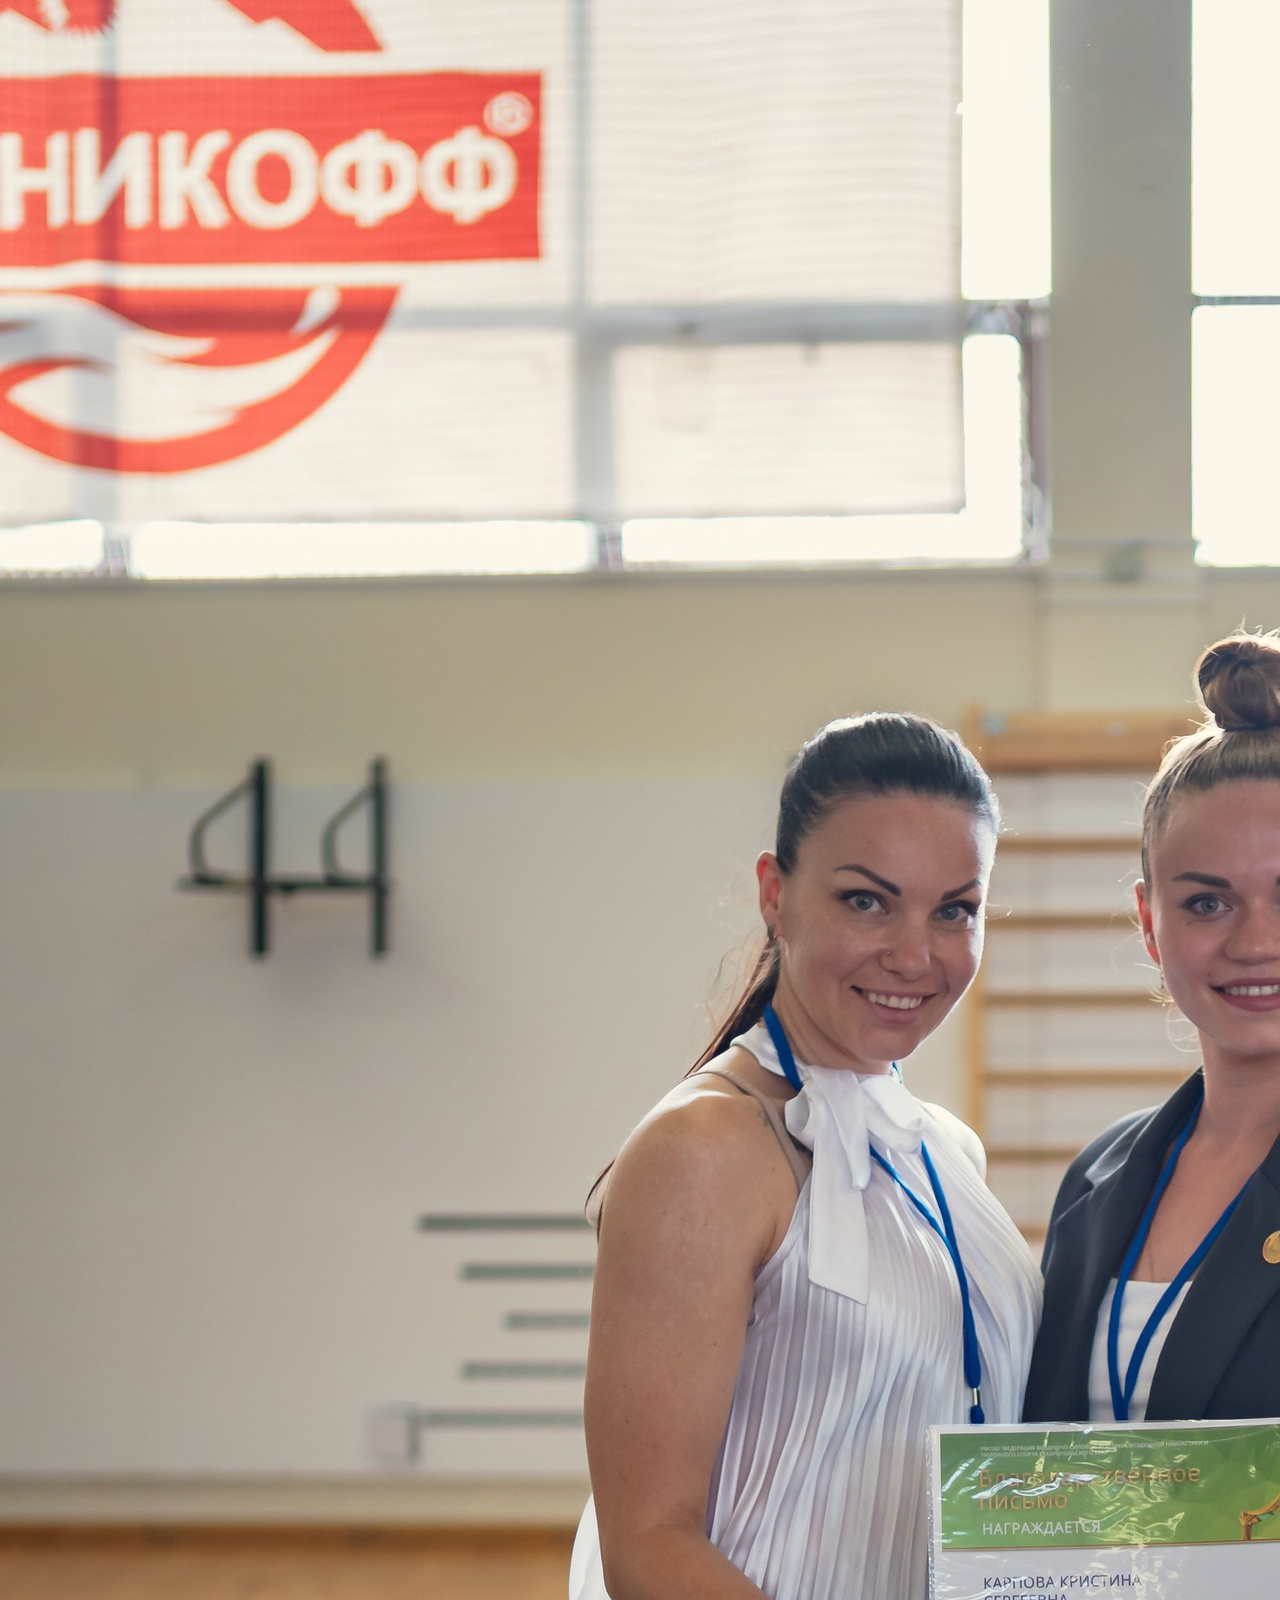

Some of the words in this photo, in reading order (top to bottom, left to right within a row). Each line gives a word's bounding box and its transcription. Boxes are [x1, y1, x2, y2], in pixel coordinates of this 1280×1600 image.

[983, 1521, 1100, 1538] НАГРАЖДАЕТСЯ
[984, 1576, 1055, 1589] КАРПОВА
[1061, 1574, 1143, 1588] КРИСТИНА
